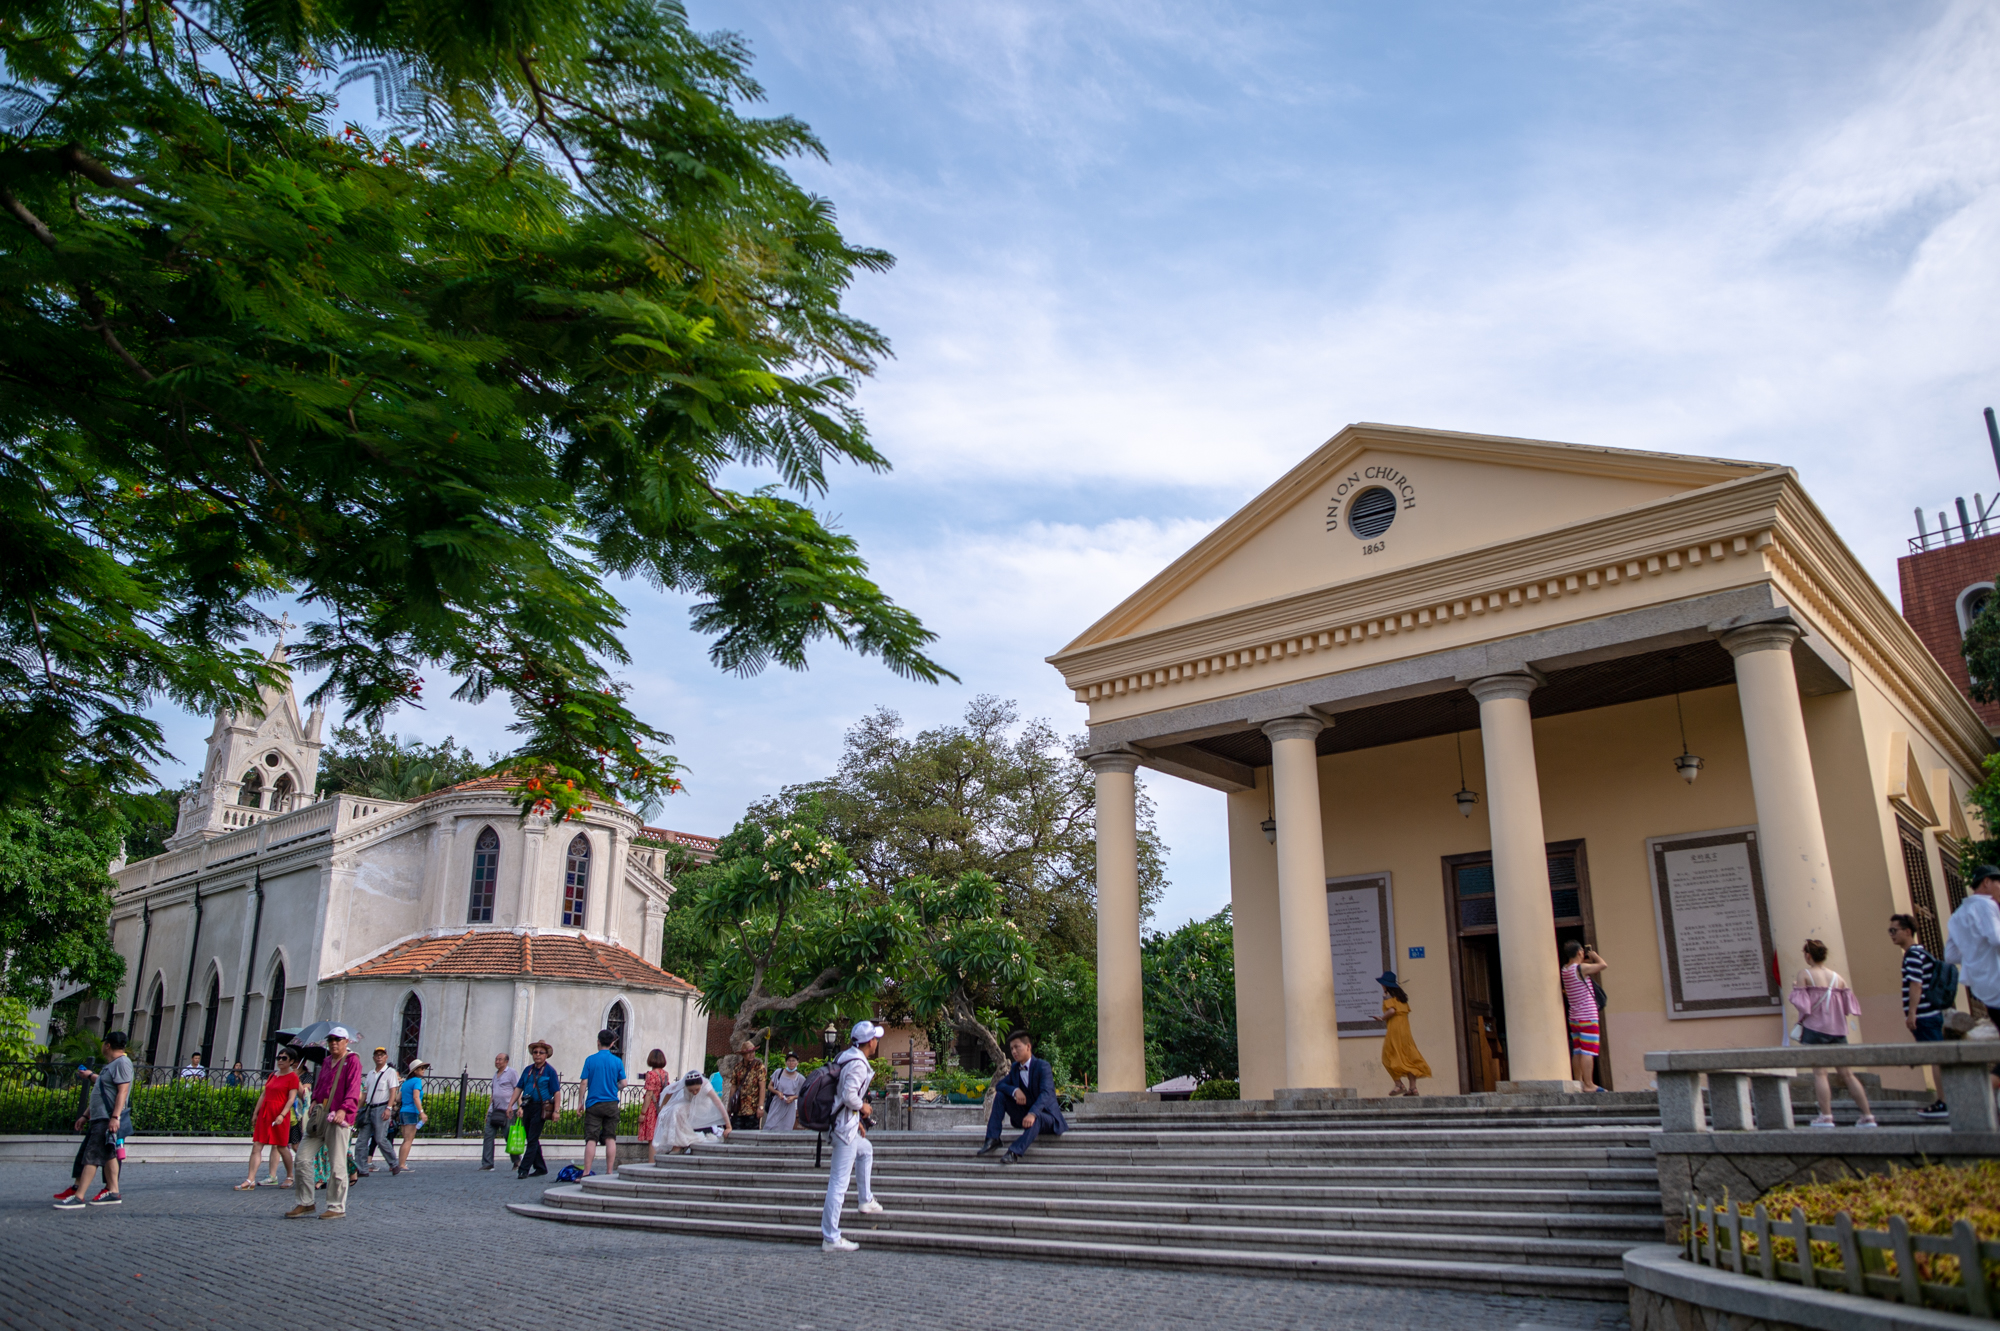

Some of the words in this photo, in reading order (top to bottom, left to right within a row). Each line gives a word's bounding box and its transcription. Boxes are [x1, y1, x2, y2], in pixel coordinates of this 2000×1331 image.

[1326, 472, 1360, 532] UNION
[1365, 466, 1415, 510] CHURCH
[1362, 541, 1385, 555] 1863
